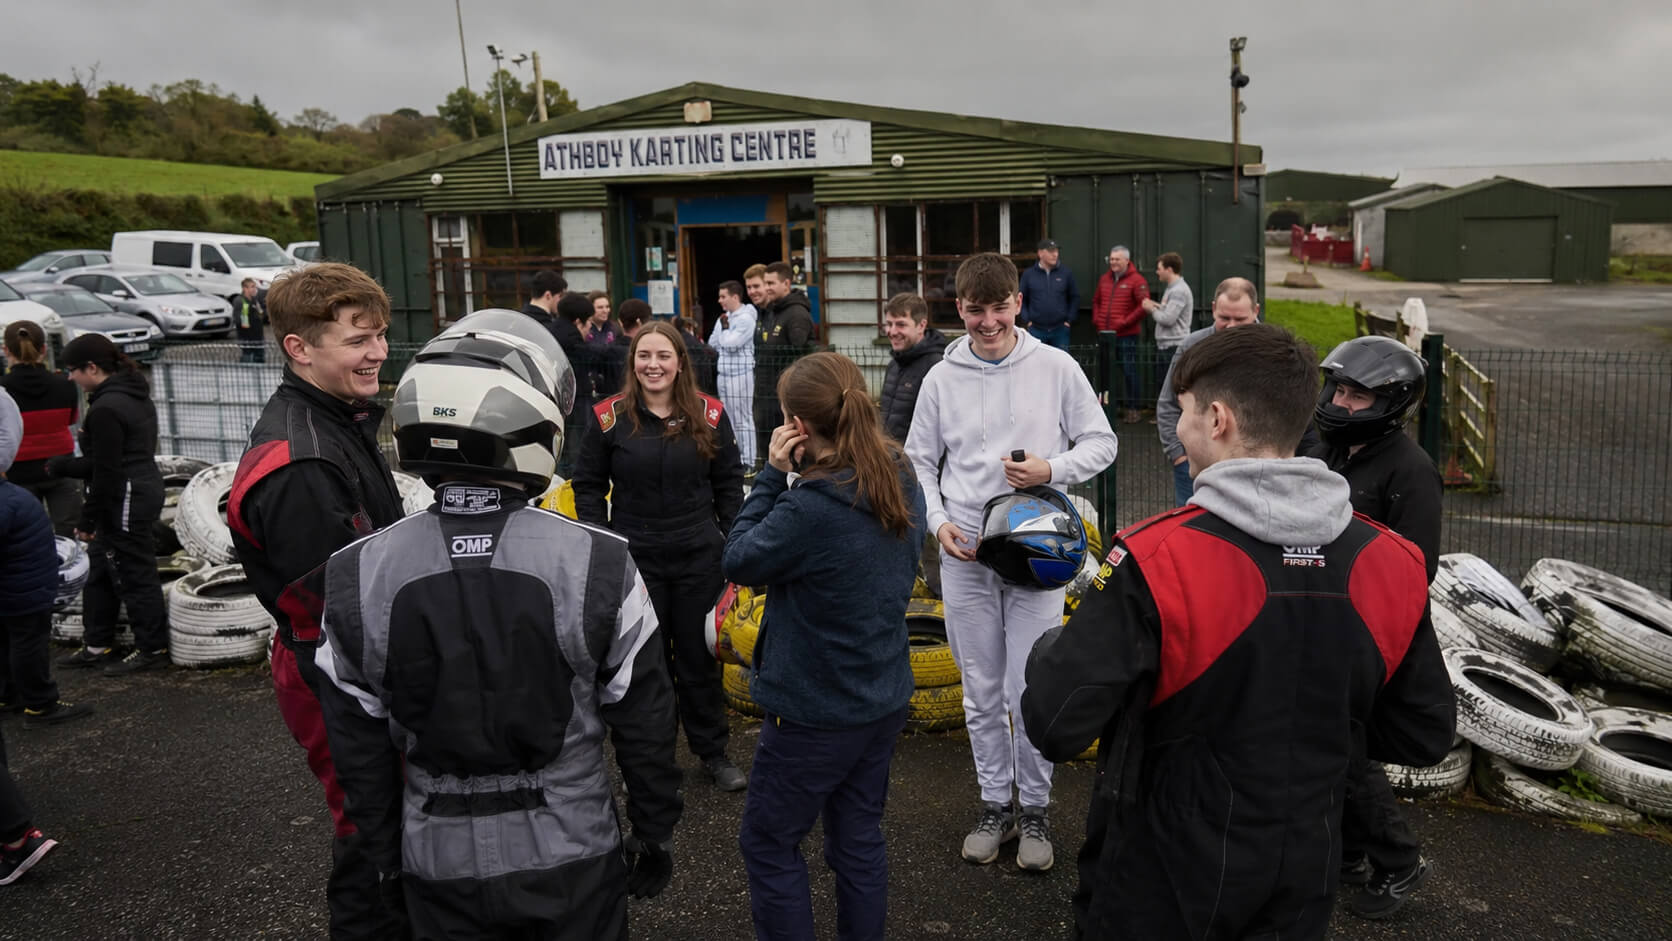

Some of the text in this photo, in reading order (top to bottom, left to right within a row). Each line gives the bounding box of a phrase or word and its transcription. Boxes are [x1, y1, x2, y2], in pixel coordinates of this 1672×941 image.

[544, 128, 817, 171] ATHBOY KARTING CENTRE
[432, 406, 457, 417] BKS
[451, 538, 493, 554] OMP
